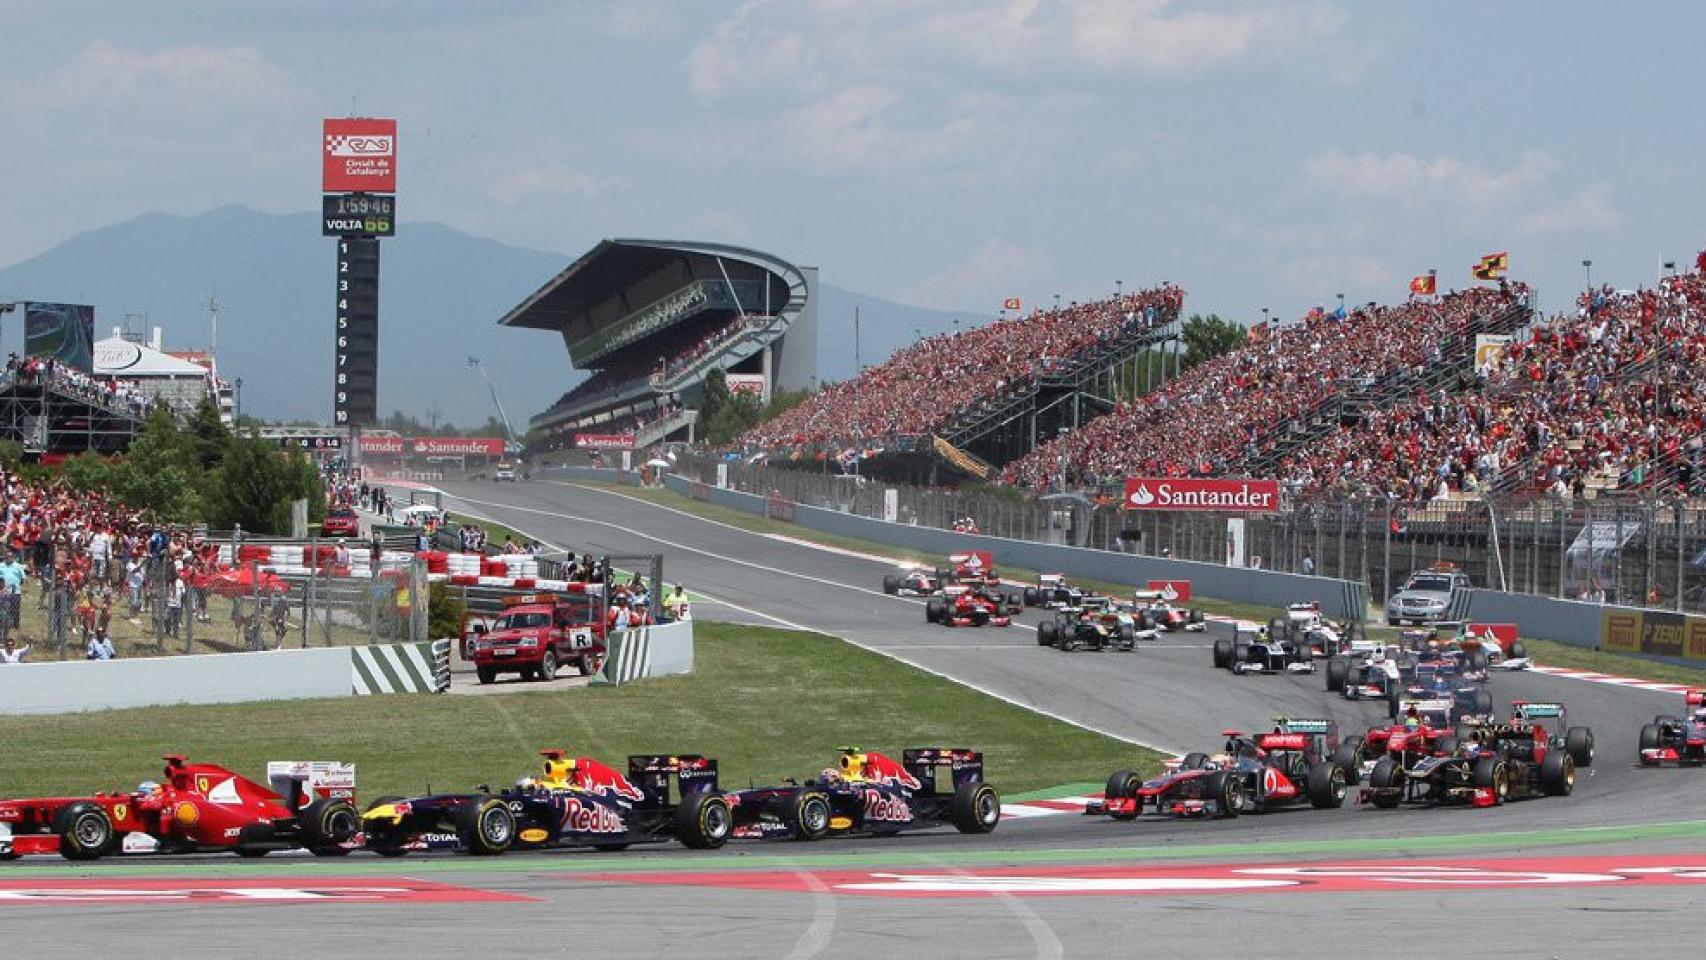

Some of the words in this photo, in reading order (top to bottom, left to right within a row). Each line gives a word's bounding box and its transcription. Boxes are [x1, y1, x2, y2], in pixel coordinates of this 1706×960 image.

[346, 159, 374, 167] Circuit
[377, 159, 388, 167] de
[346, 167, 390, 176] Catalunya
[326, 220, 362, 230] VOLTA
[341, 243, 348, 253] 1
[340, 262, 348, 272] 2
[340, 280, 348, 291] 3
[339, 299, 348, 309] 4
[339, 318, 348, 328] 5
[338, 336, 347, 347] 6
[338, 355, 346, 365] 7
[338, 374, 346, 384] 8
[338, 392, 346, 402] 9
[336, 411, 348, 422] 10
[428, 441, 490, 453] Santander
[1158, 484, 1271, 507] Santander
[576, 634, 586, 647] R
[863, 789, 894, 820] Red
[561, 797, 601, 832] Red
[426, 833, 459, 842] TOTAL
